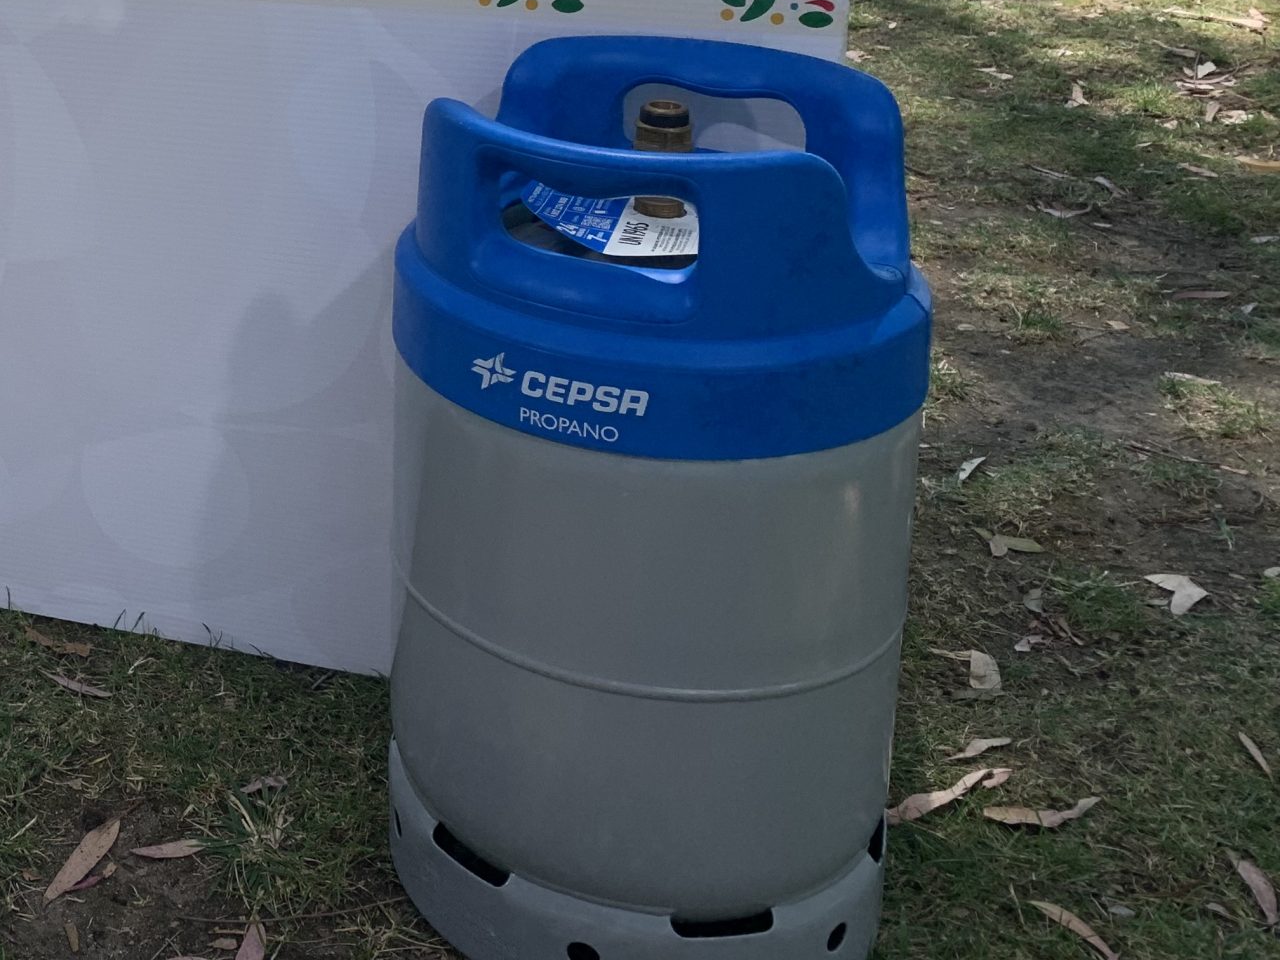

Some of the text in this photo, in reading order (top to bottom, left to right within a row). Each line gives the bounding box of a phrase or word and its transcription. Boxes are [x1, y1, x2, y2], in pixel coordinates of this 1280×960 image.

[617, 221, 650, 247] UN 1965
[520, 370, 650, 417] CEPSA
[519, 406, 620, 442] PROPANO
